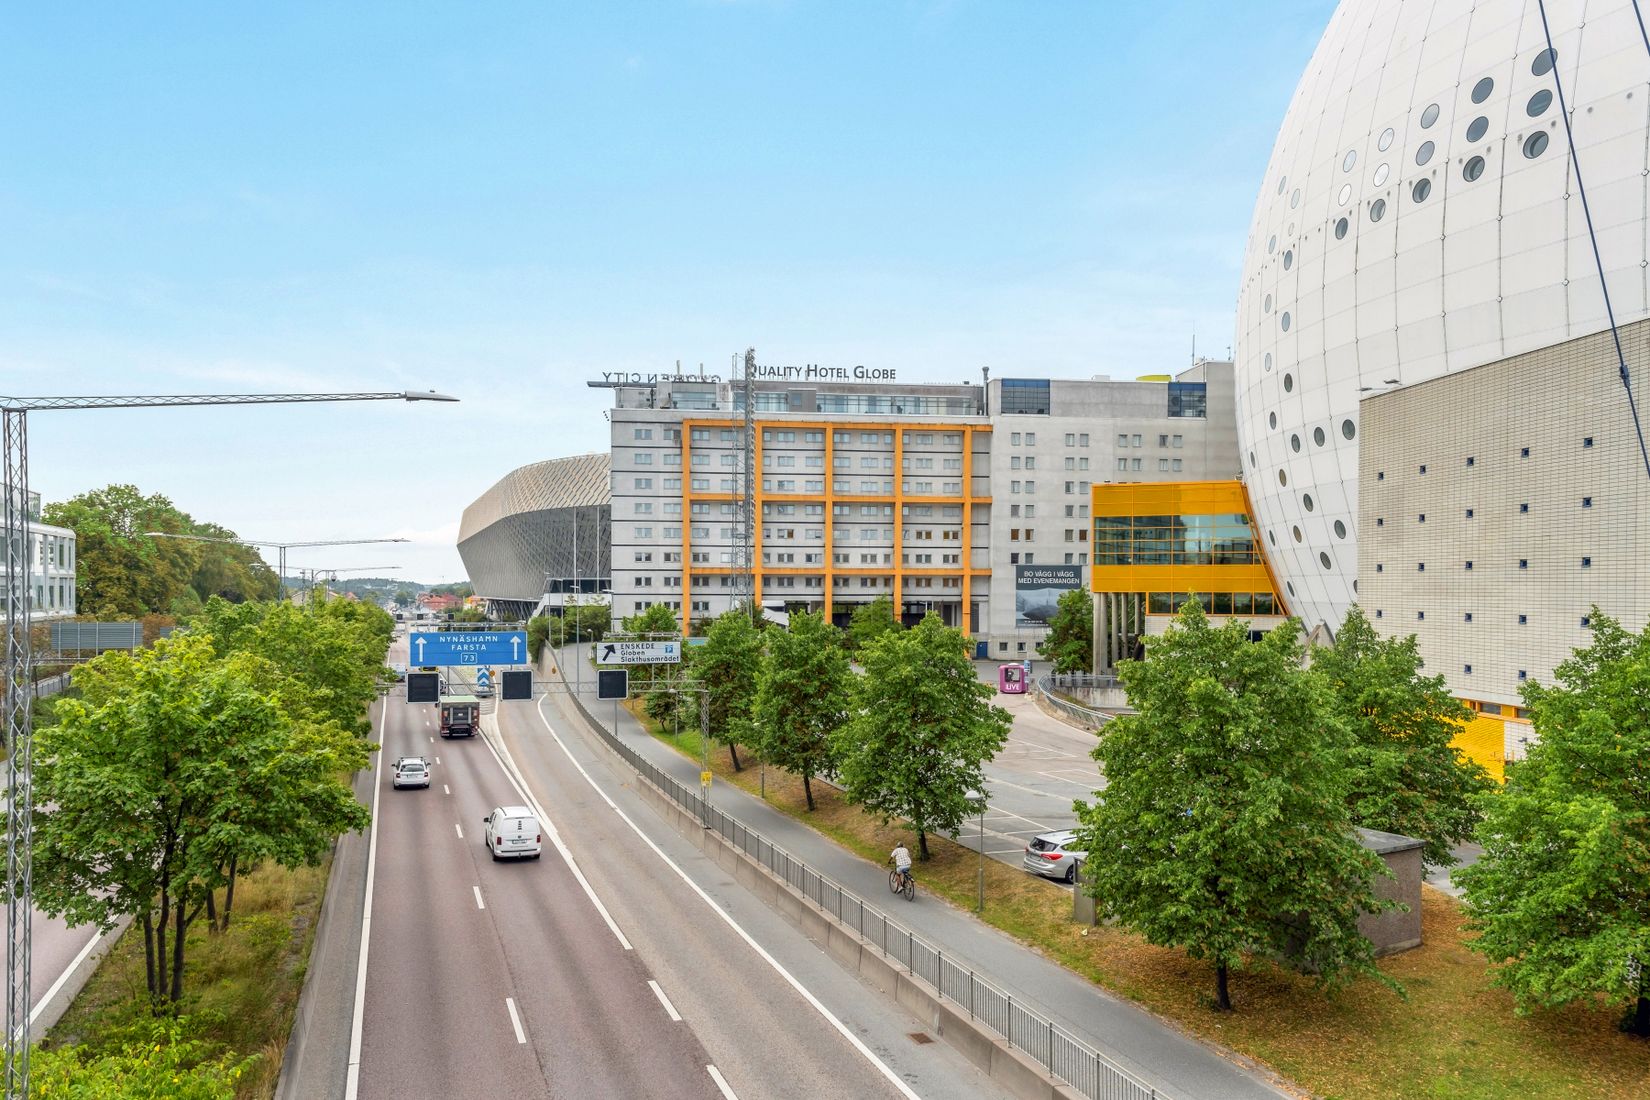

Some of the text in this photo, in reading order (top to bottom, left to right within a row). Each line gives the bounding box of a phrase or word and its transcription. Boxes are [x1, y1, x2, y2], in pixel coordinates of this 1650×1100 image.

[751, 362, 897, 380] UALITY HOTEL GLOBE
[1023, 570, 1034, 578] BO
[439, 634, 498, 643] NYNÄSHAMN
[451, 643, 487, 651] FARSTA
[620, 642, 656, 650] ENSKEDE
[463, 654, 475, 662] 73
[620, 655, 680, 663] Slakthusområdet
[1005, 683, 1020, 691] LIVE
